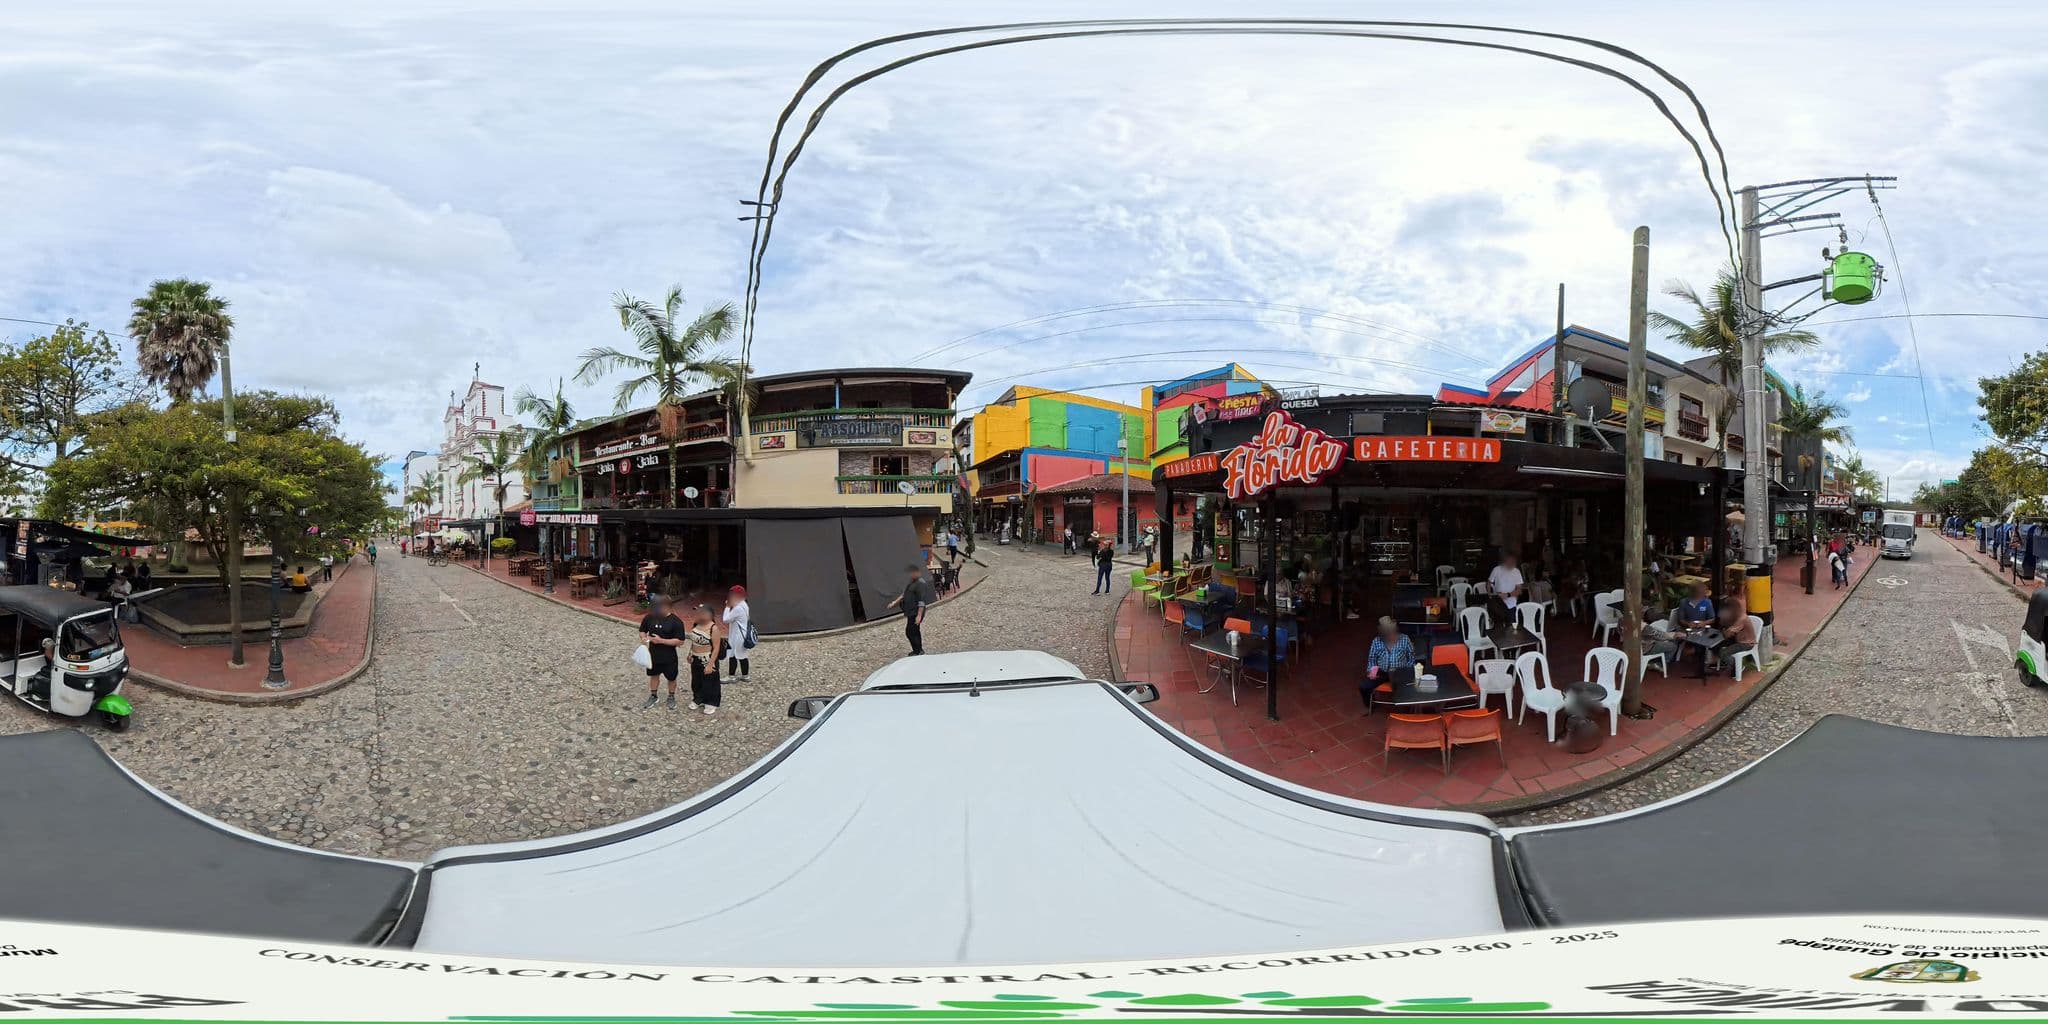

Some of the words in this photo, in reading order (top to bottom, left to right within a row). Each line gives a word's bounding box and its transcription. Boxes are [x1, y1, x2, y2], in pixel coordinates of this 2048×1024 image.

[820, 421, 900, 438] ABSOLUTTO
[1253, 412, 1298, 457] La
[640, 434, 657, 446] Bar
[1360, 440, 1493, 460] CAFETERIA
[1166, 457, 1214, 474] PANADERIA
[1221, 430, 1343, 499] Florida
[1819, 495, 1845, 505] PIZZA
[581, 514, 599, 524] BAR
